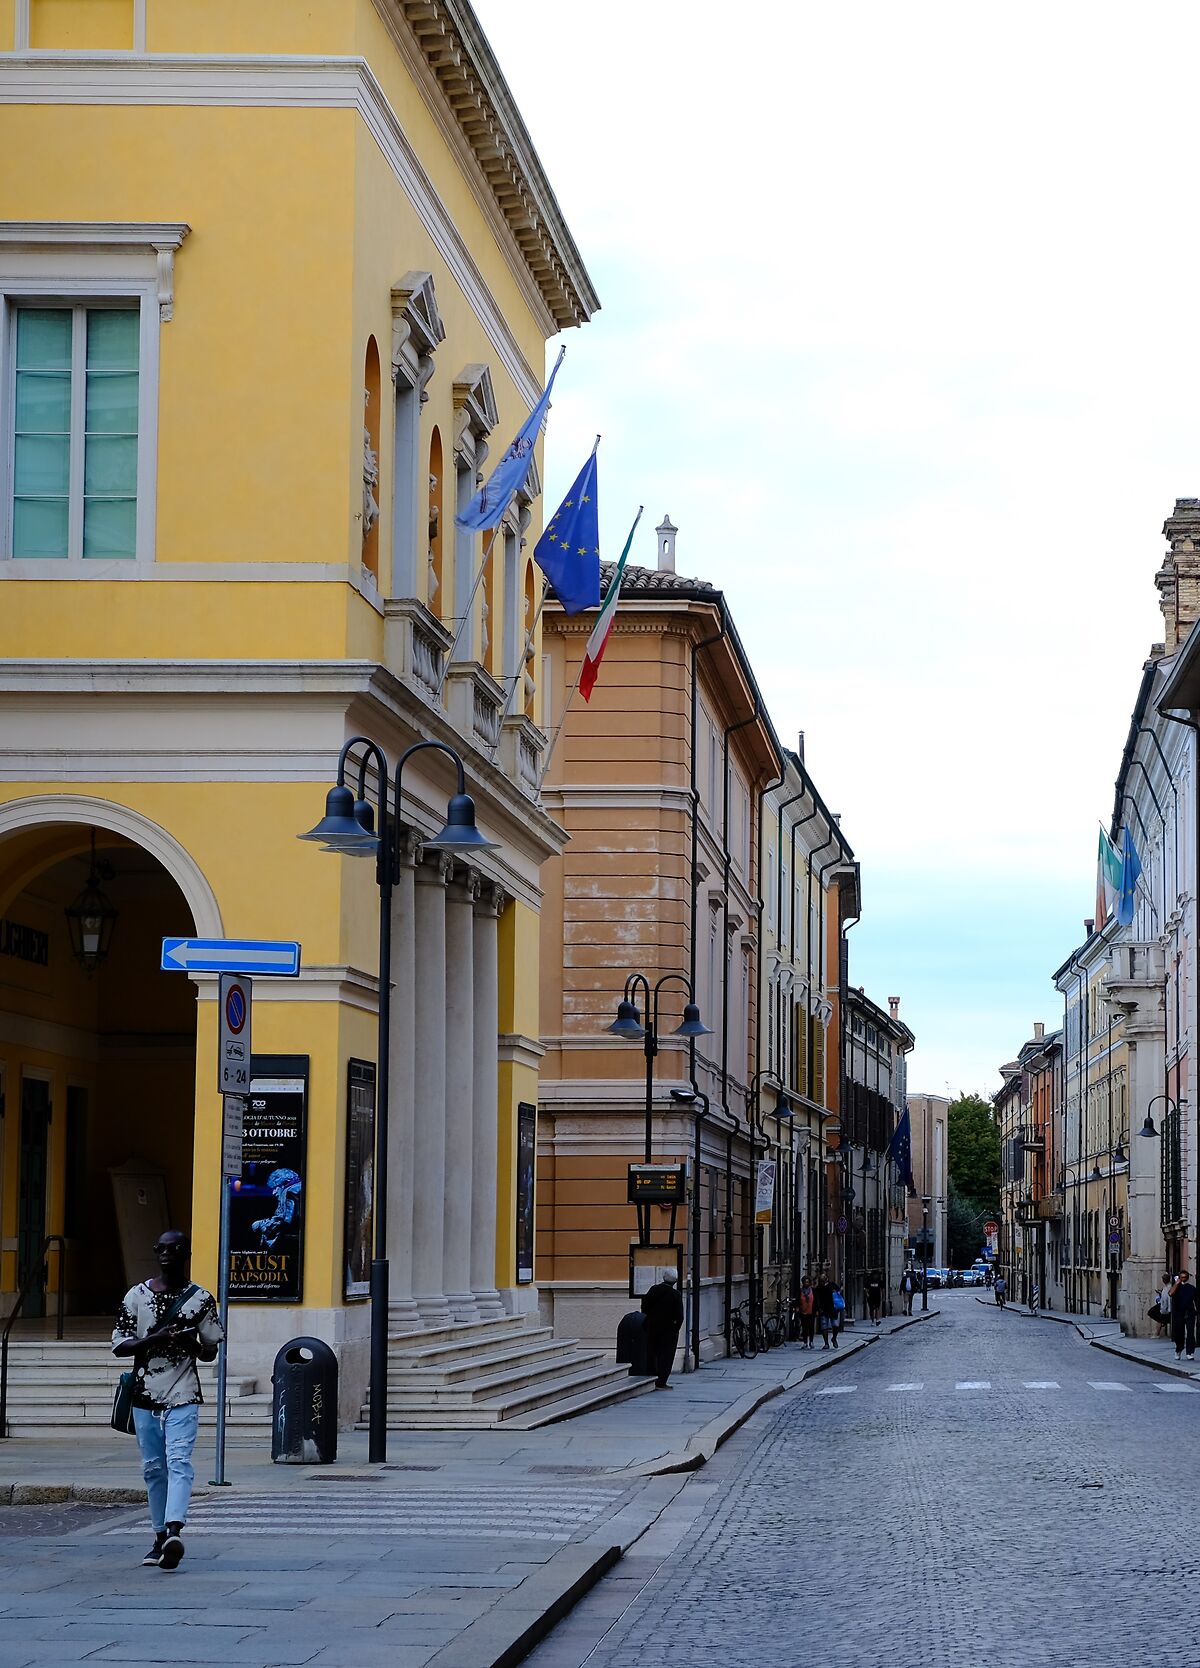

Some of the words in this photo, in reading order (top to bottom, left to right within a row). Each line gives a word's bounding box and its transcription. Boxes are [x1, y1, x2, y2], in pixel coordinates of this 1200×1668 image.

[224, 1068, 229, 1081] 6
[237, 1070, 246, 1084] 24
[249, 1128, 297, 1138] OTTOBRE
[230, 1255, 290, 1271] FAUST
[230, 1271, 289, 1281] RAPSODIA
